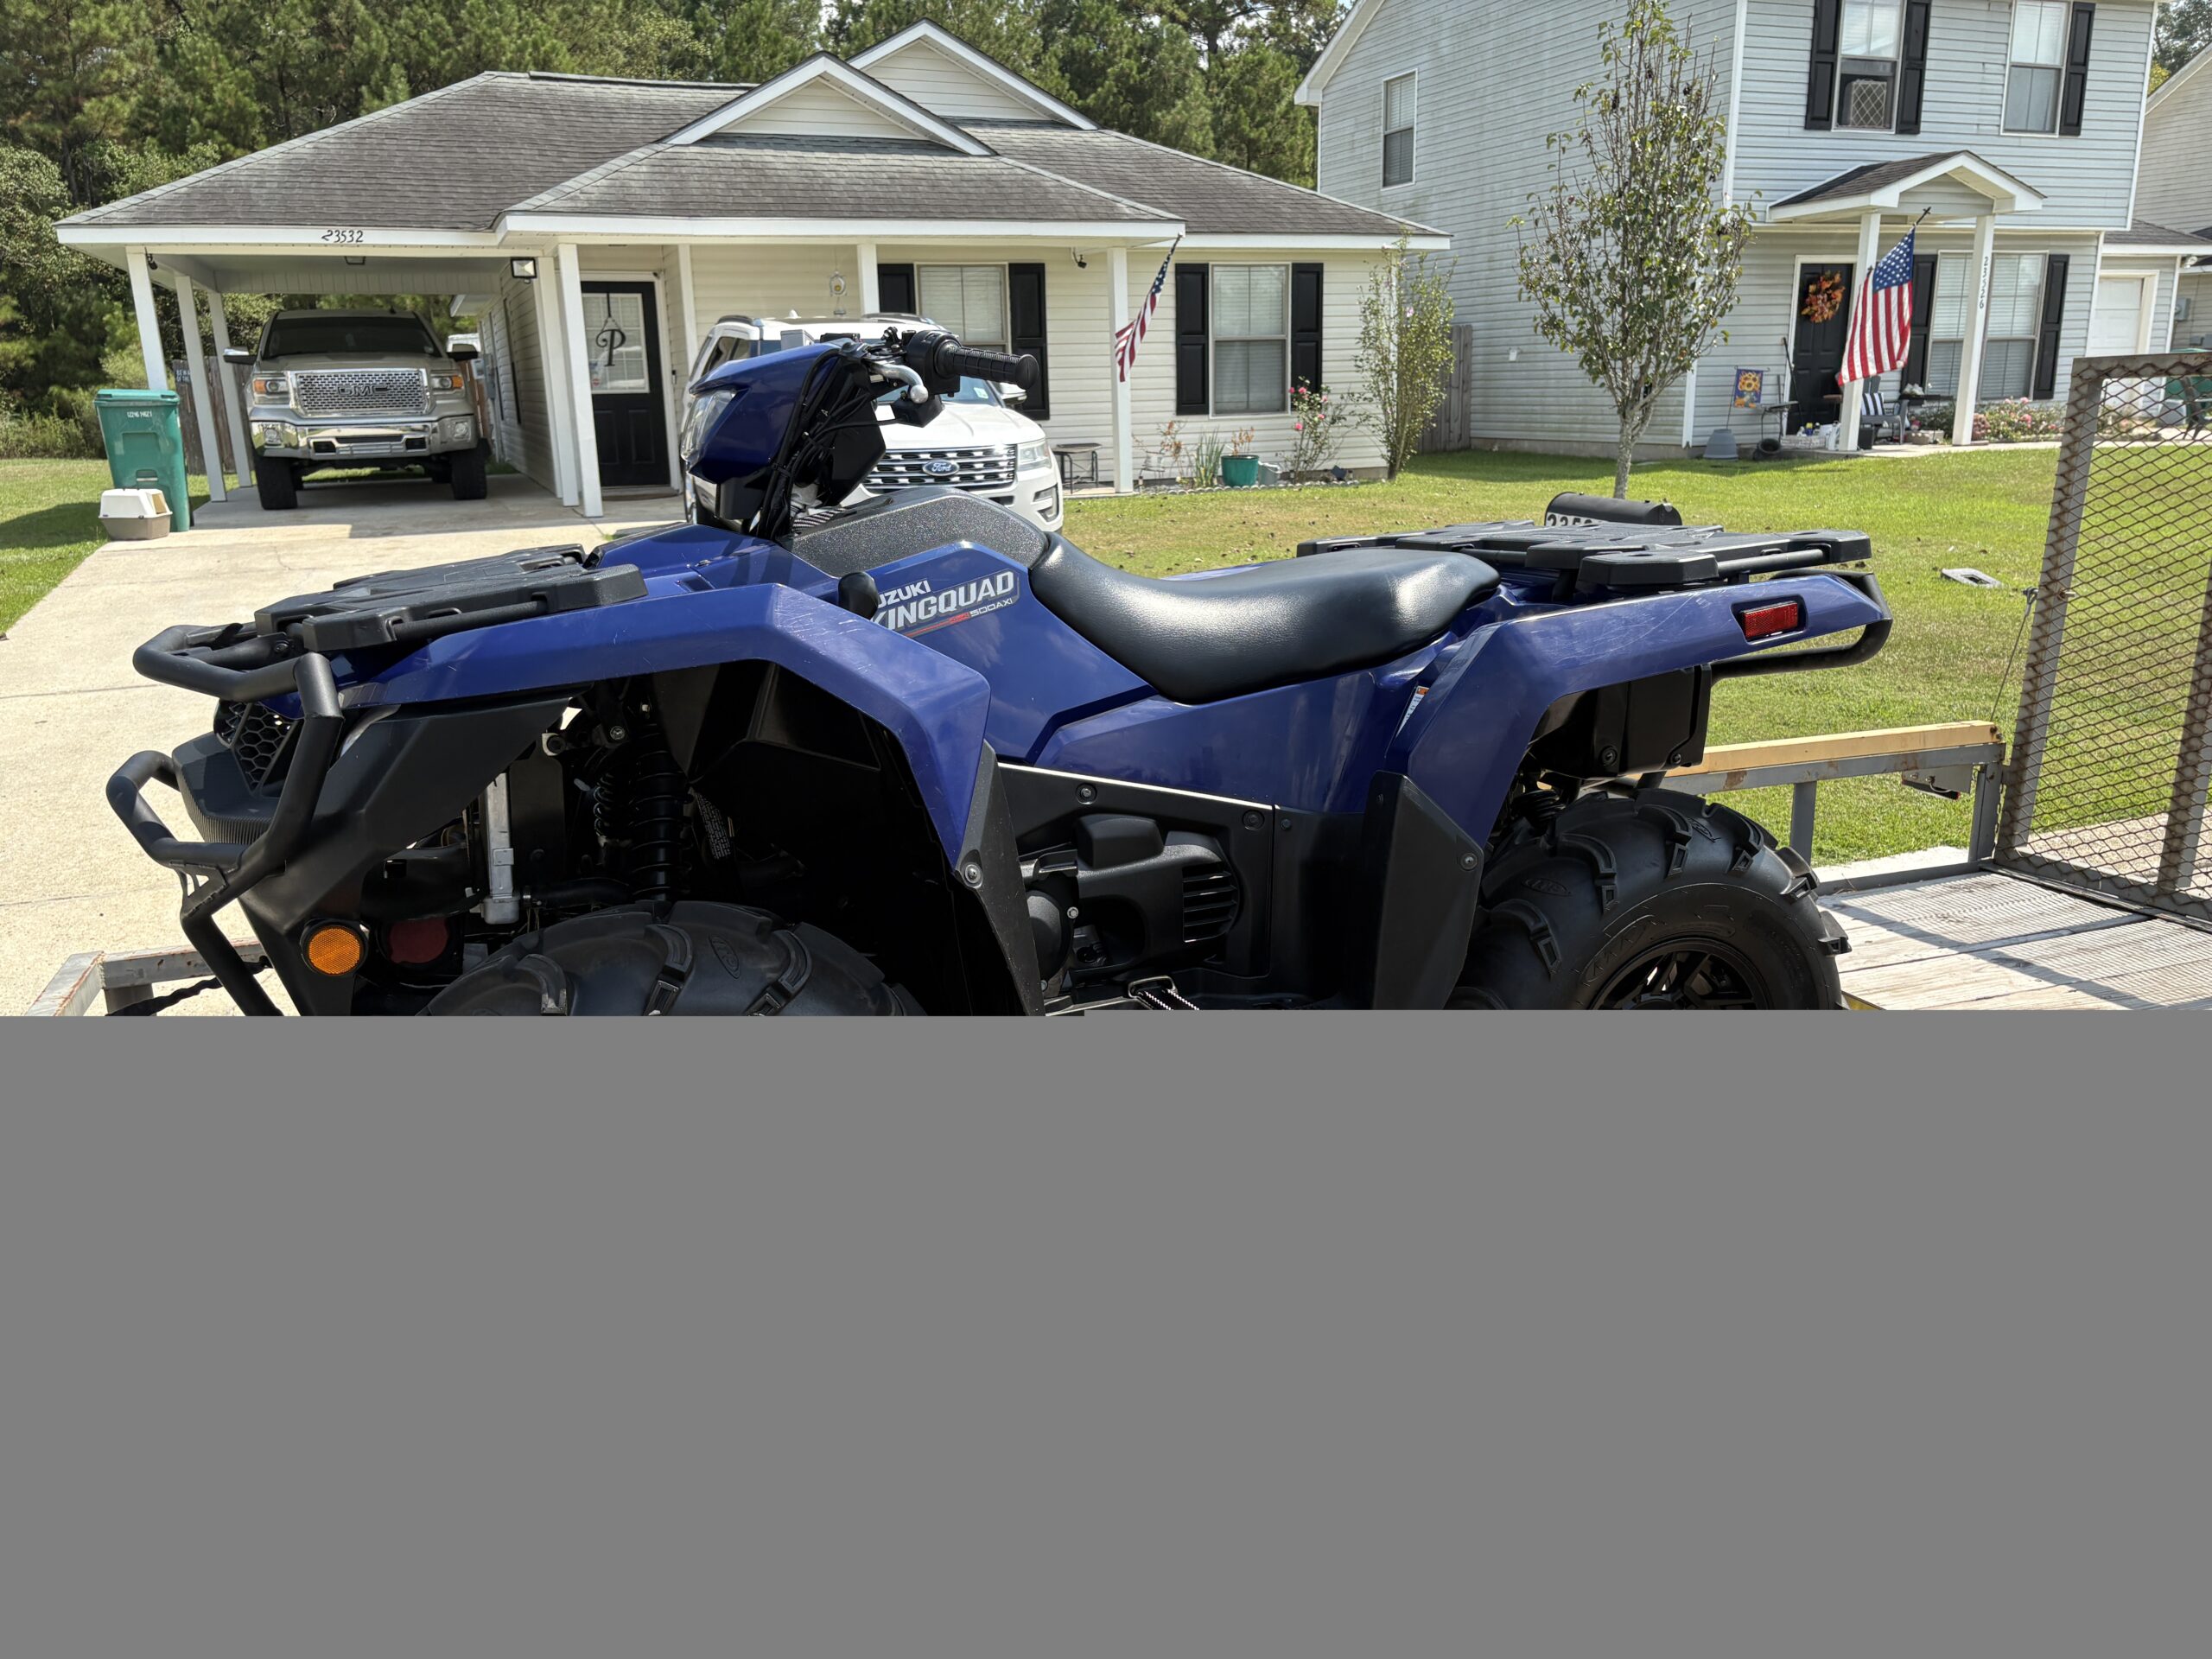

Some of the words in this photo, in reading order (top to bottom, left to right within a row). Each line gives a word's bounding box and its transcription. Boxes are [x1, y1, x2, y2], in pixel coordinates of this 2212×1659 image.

[321, 229, 364, 243] 23532
[1979, 256, 1989, 309] 23526
[595, 328, 626, 367] P
[336, 384, 388, 397] GMC
[931, 462, 951, 473] Ford
[877, 580, 931, 608] UZUKI
